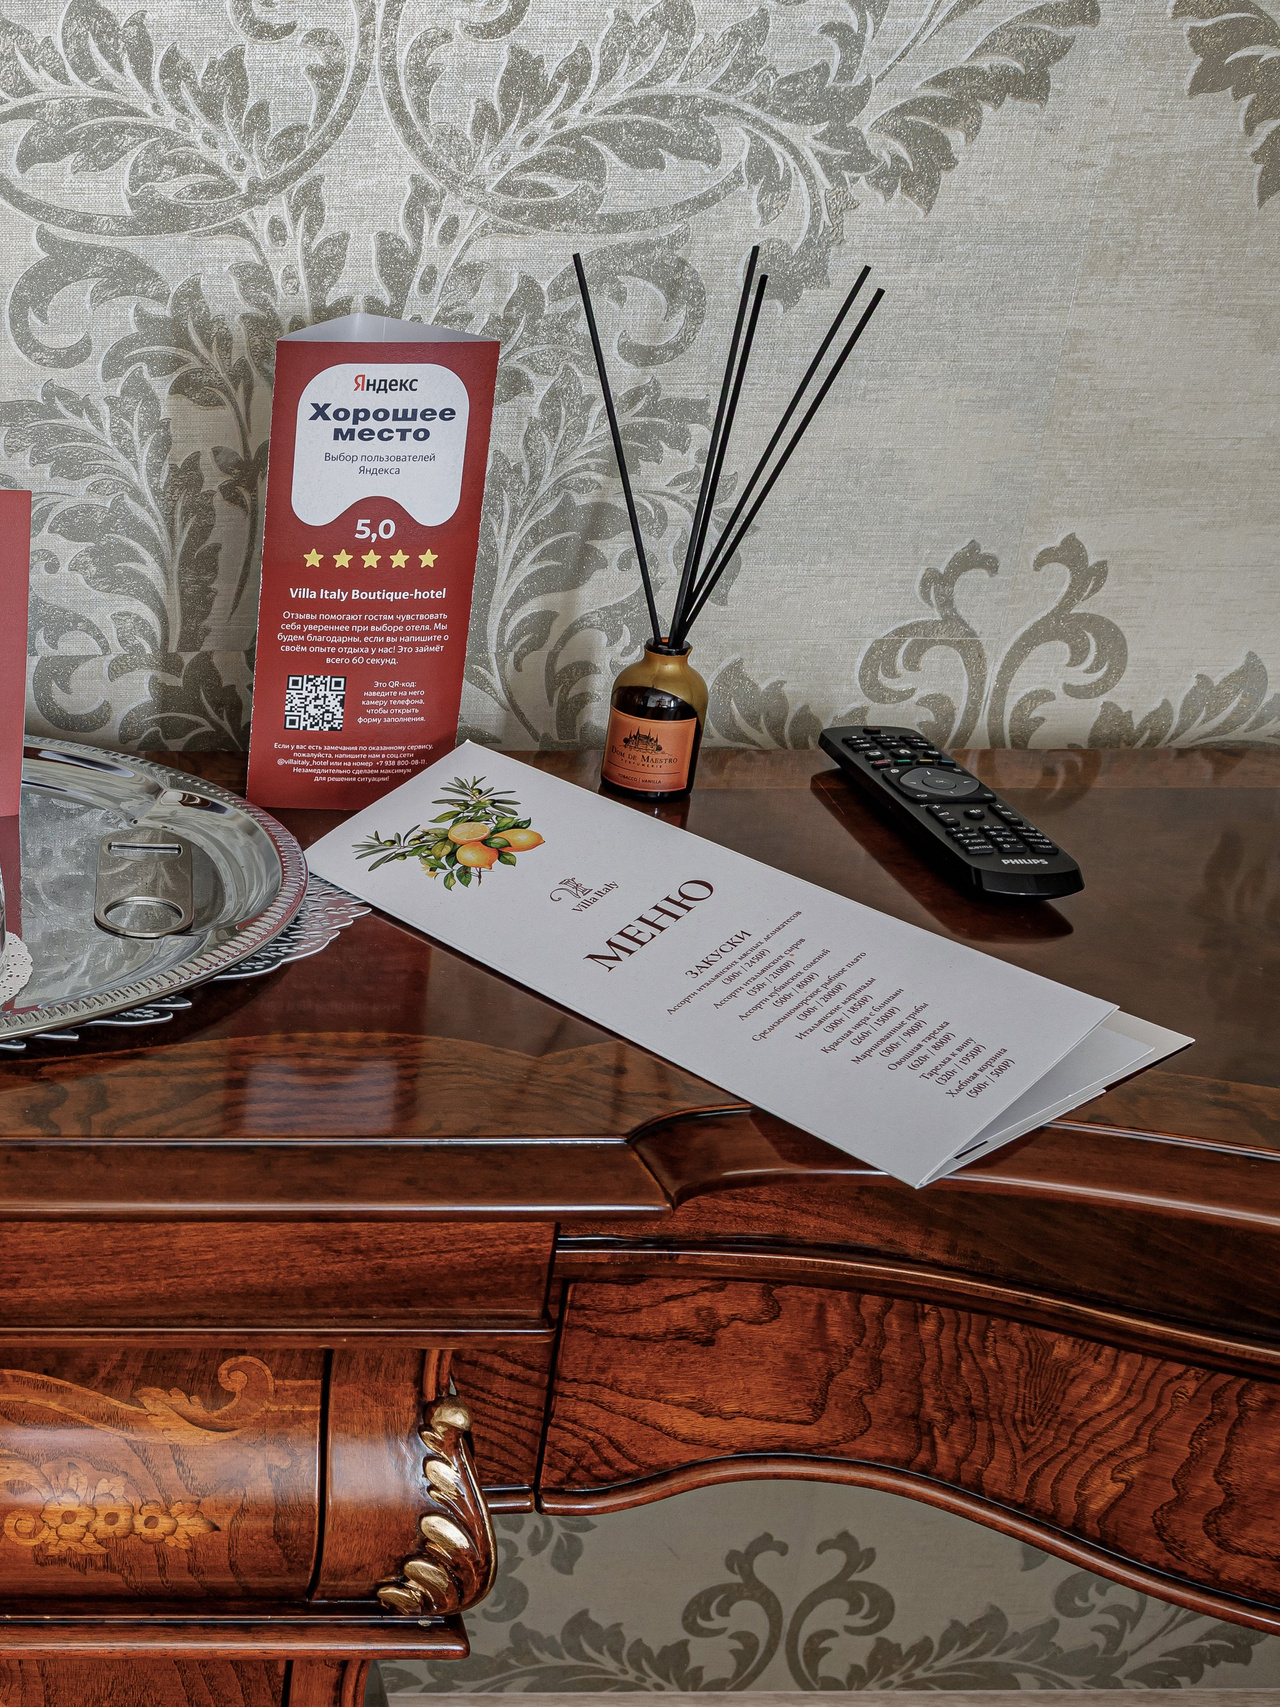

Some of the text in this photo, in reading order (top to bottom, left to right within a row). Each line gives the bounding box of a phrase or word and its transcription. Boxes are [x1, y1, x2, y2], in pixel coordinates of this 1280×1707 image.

[354, 374, 418, 393] Яндекс
[308, 403, 456, 425] Хорошее
[333, 428, 430, 441] место
[325, 453, 435, 463] Выбор пользователей
[358, 466, 400, 476] Яндекса
[355, 519, 396, 542] 5,0
[290, 588, 446, 602] Villa Italy Boutique-hotel
[283, 611, 447, 622] Отзывы помогают гостям чувствовать
[281, 622, 301, 630] себя
[303, 624, 350, 632] увереннее
[371, 623, 403, 632] выборе
[406, 623, 431, 631] отеля.
[277, 633, 304, 642] будем
[280, 644, 307, 652] своём
[338, 646, 369, 655] отдыха
[371, 647, 375, 655] у
[378, 645, 395, 653] нас!
[398, 645, 412, 653] Это
[414, 644, 444, 653] займёт
[352, 656, 364, 664] 60
[366, 657, 398, 666] секунд.
[357, 716, 381, 724] форму
[293, 767, 351, 775] Незамедлительно
[572, 896, 599, 914] Villa
[598, 880, 619, 898] Italy
[582, 879, 714, 973] МЕНЮ
[667, 910, 802, 1015] Ассорти итальянских мясных деликатесов
[685, 930, 752, 979] ЗАКУСКИ
[713, 938, 806, 1010] Ассорти итальянских сыров
[722, 969, 742, 985] (300г
[739, 948, 830, 1021] Ассорти кубанских солений
[746, 982, 768, 996] (350г
[752, 952, 866, 1042] Средиземноморское рыбное плато
[773, 992, 794, 1008] (500г
[795, 977, 876, 1040] Итальянские маринады
[796, 1006, 818, 1021] (300г
[820, 1030, 853, 1054] Красная
[852, 1016, 870, 1031] икра
[872, 988, 904, 1013] блинами
[823, 1017, 845, 1033] (300г
[850, 1002, 929, 1064] Маринованные грибы
[850, 1029, 872, 1046] (260г
[879, 1040, 902, 1058] (300г
[887, 1021, 950, 1071] Овощная тарелка
[907, 1053, 930, 1071] (620г
[919, 1055, 952, 1081] Тарелка
[956, 1037, 976, 1052] вину
[935, 1068, 958, 1086] (320г
[945, 1048, 1008, 1098] Хлебная корзина
[966, 1081, 989, 1098] (500г
